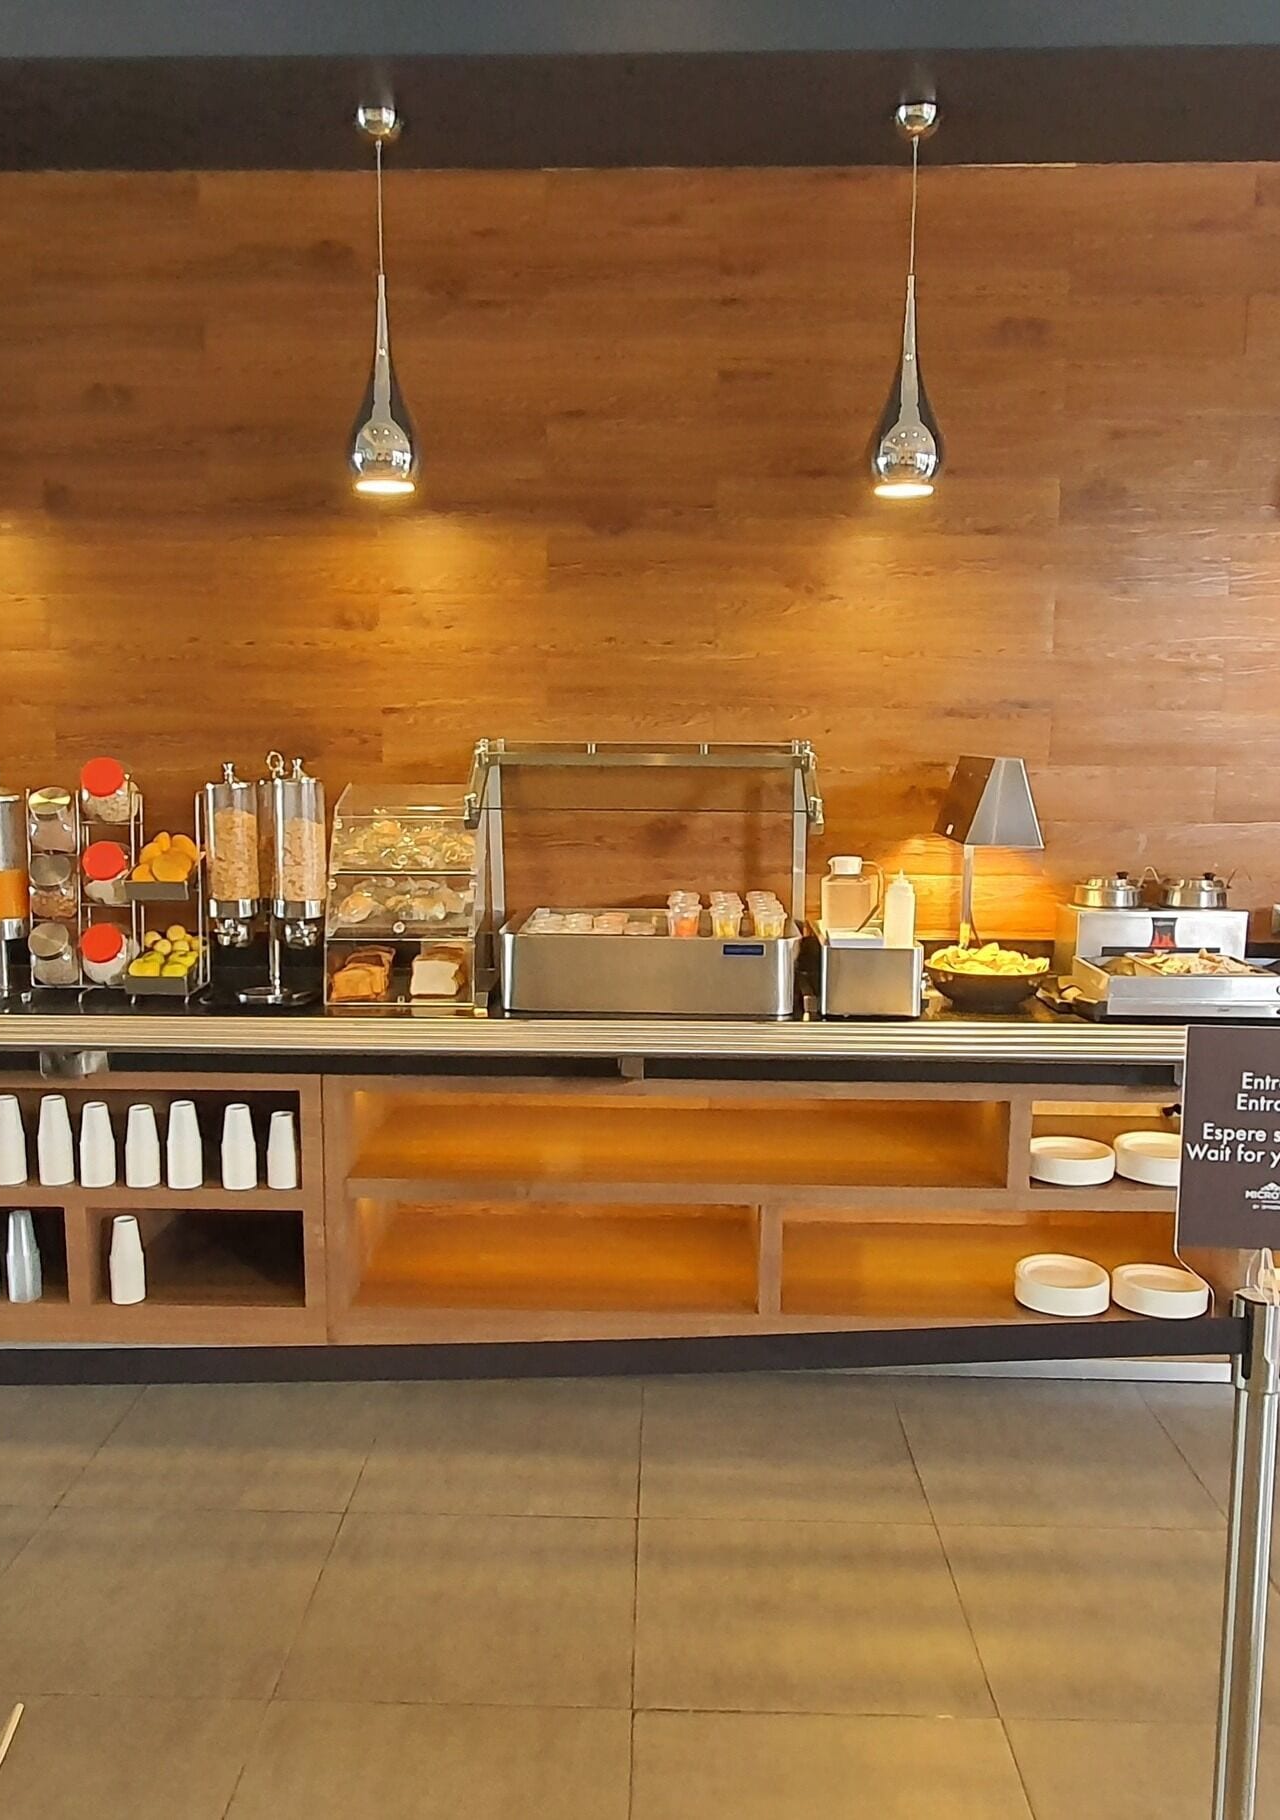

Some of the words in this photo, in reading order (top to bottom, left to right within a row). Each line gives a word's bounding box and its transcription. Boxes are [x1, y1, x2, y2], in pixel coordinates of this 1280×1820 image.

[1202, 1122, 1267, 1145] Espere
[1186, 1143, 1231, 1162] Wait
[1236, 1144, 1265, 1163] for
